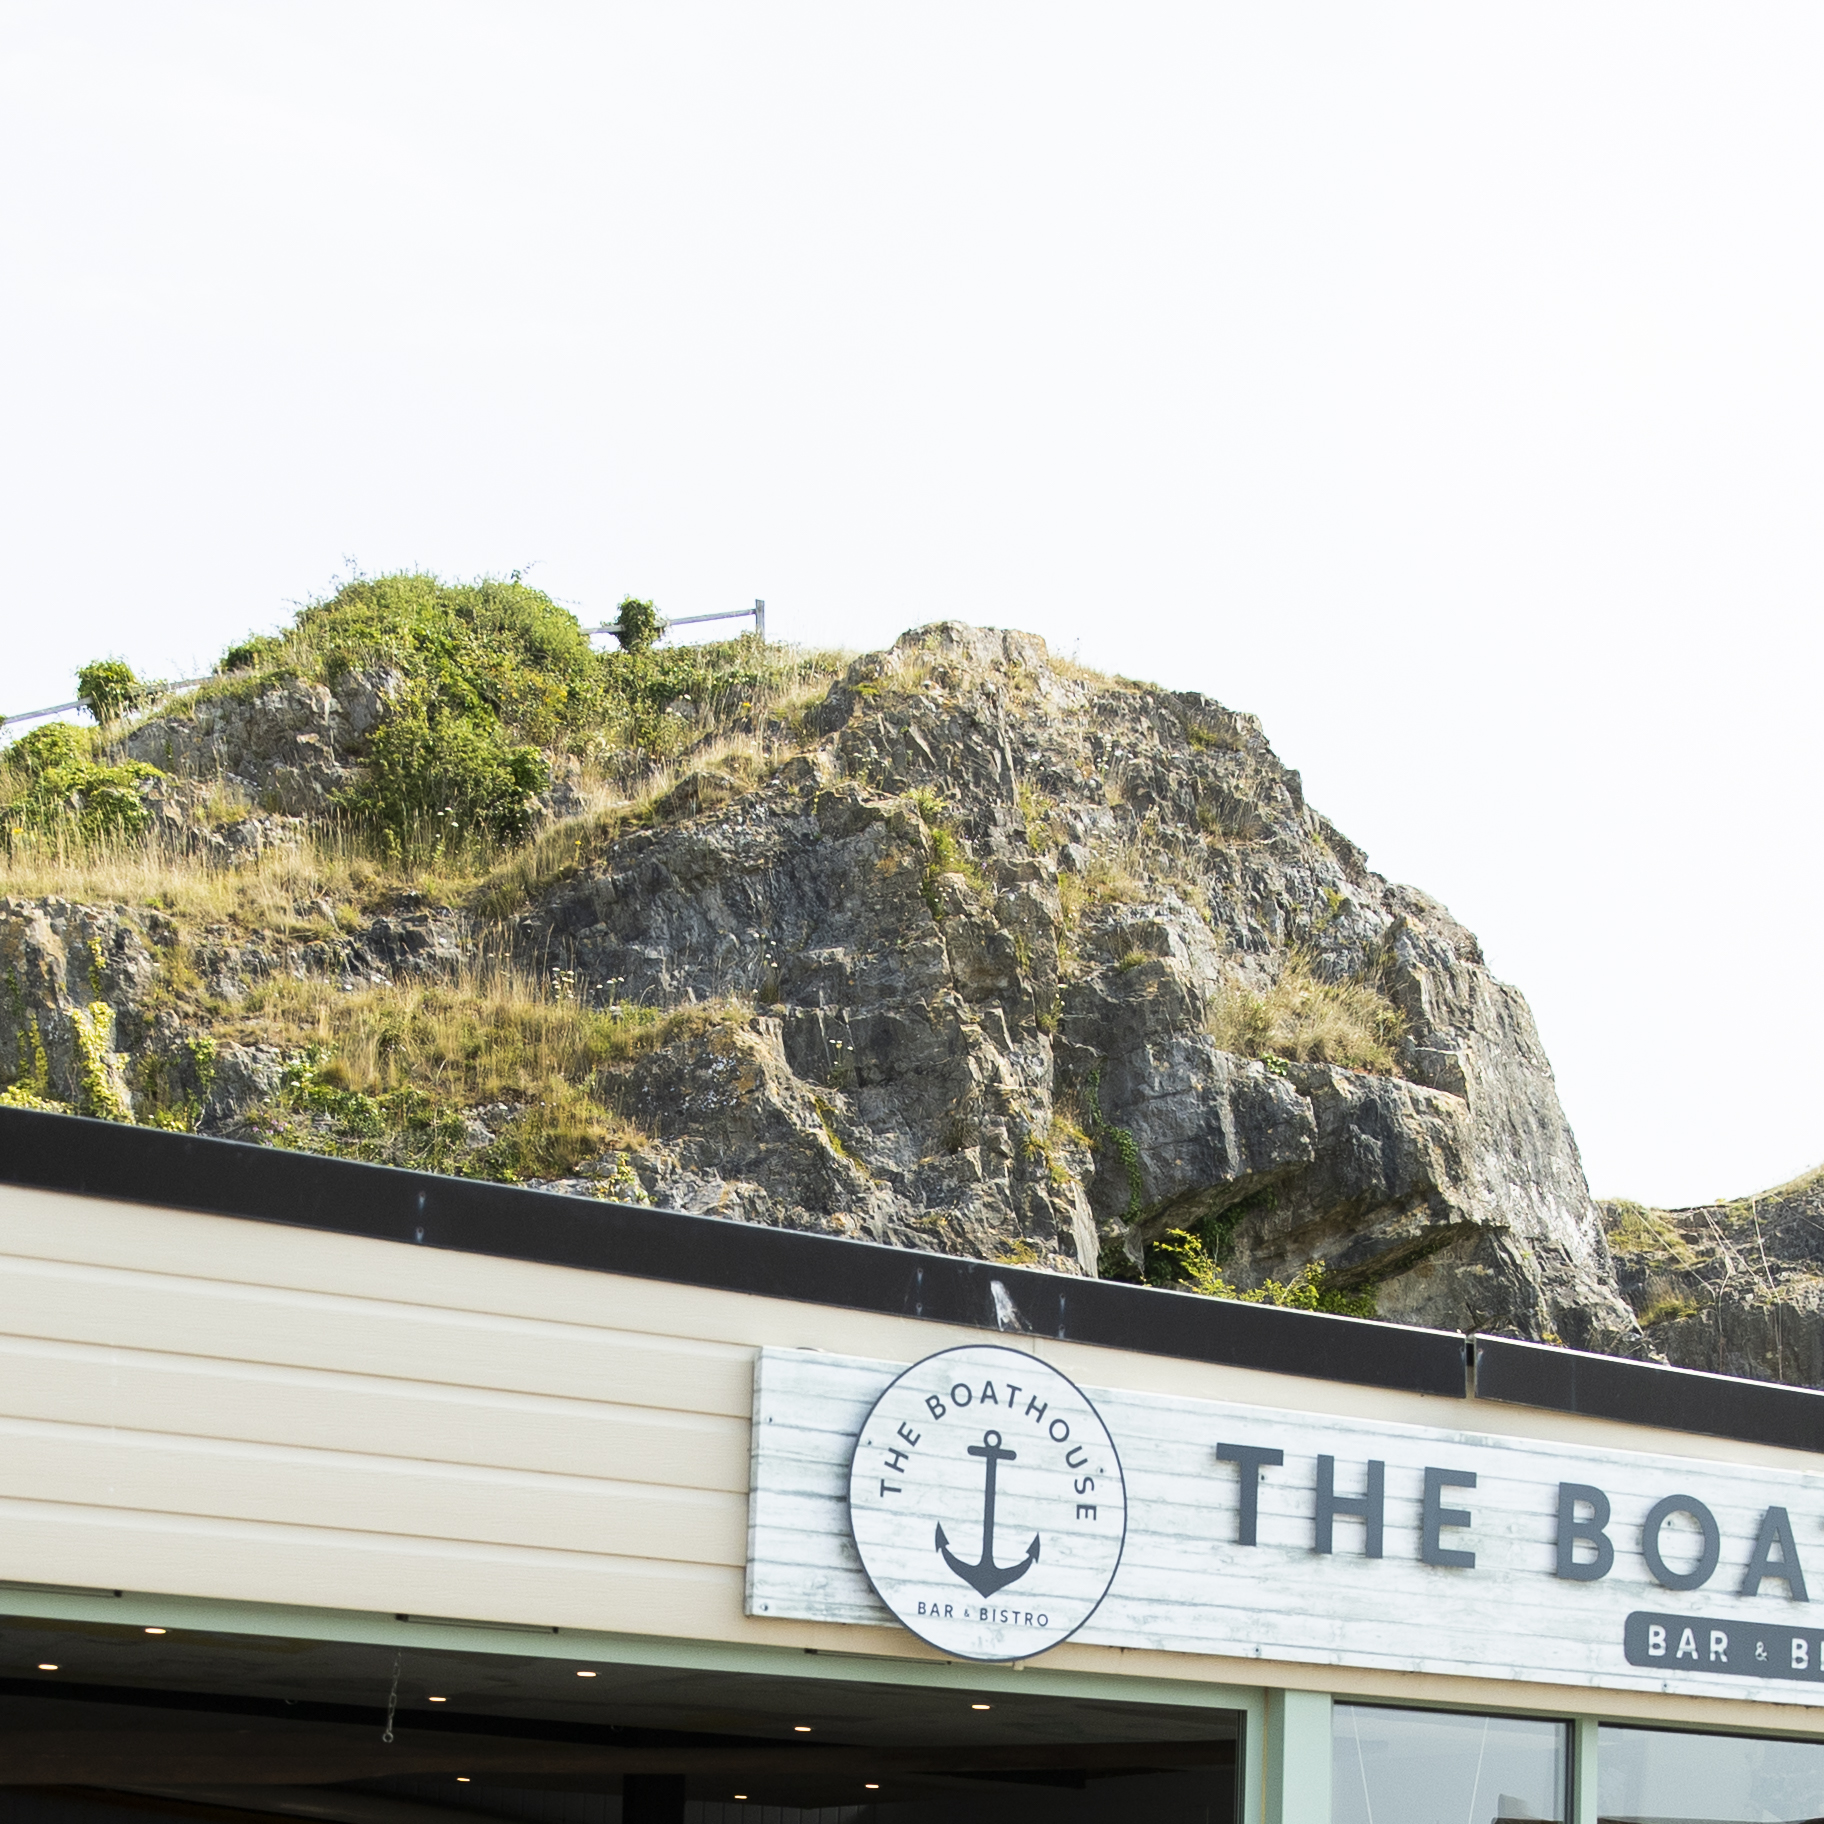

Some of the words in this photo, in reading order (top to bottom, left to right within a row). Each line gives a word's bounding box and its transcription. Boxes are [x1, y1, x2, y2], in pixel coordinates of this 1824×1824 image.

[880, 1421, 921, 1497] THE
[925, 1380, 1097, 1521] BOATHOUSE
[1216, 1443, 1478, 1568] THE
[917, 1601, 954, 1618] BAR
[979, 1608, 1049, 1627] BISTRO
[1648, 1624, 1729, 1663] BAR
[1755, 1641, 1768, 1662] &
